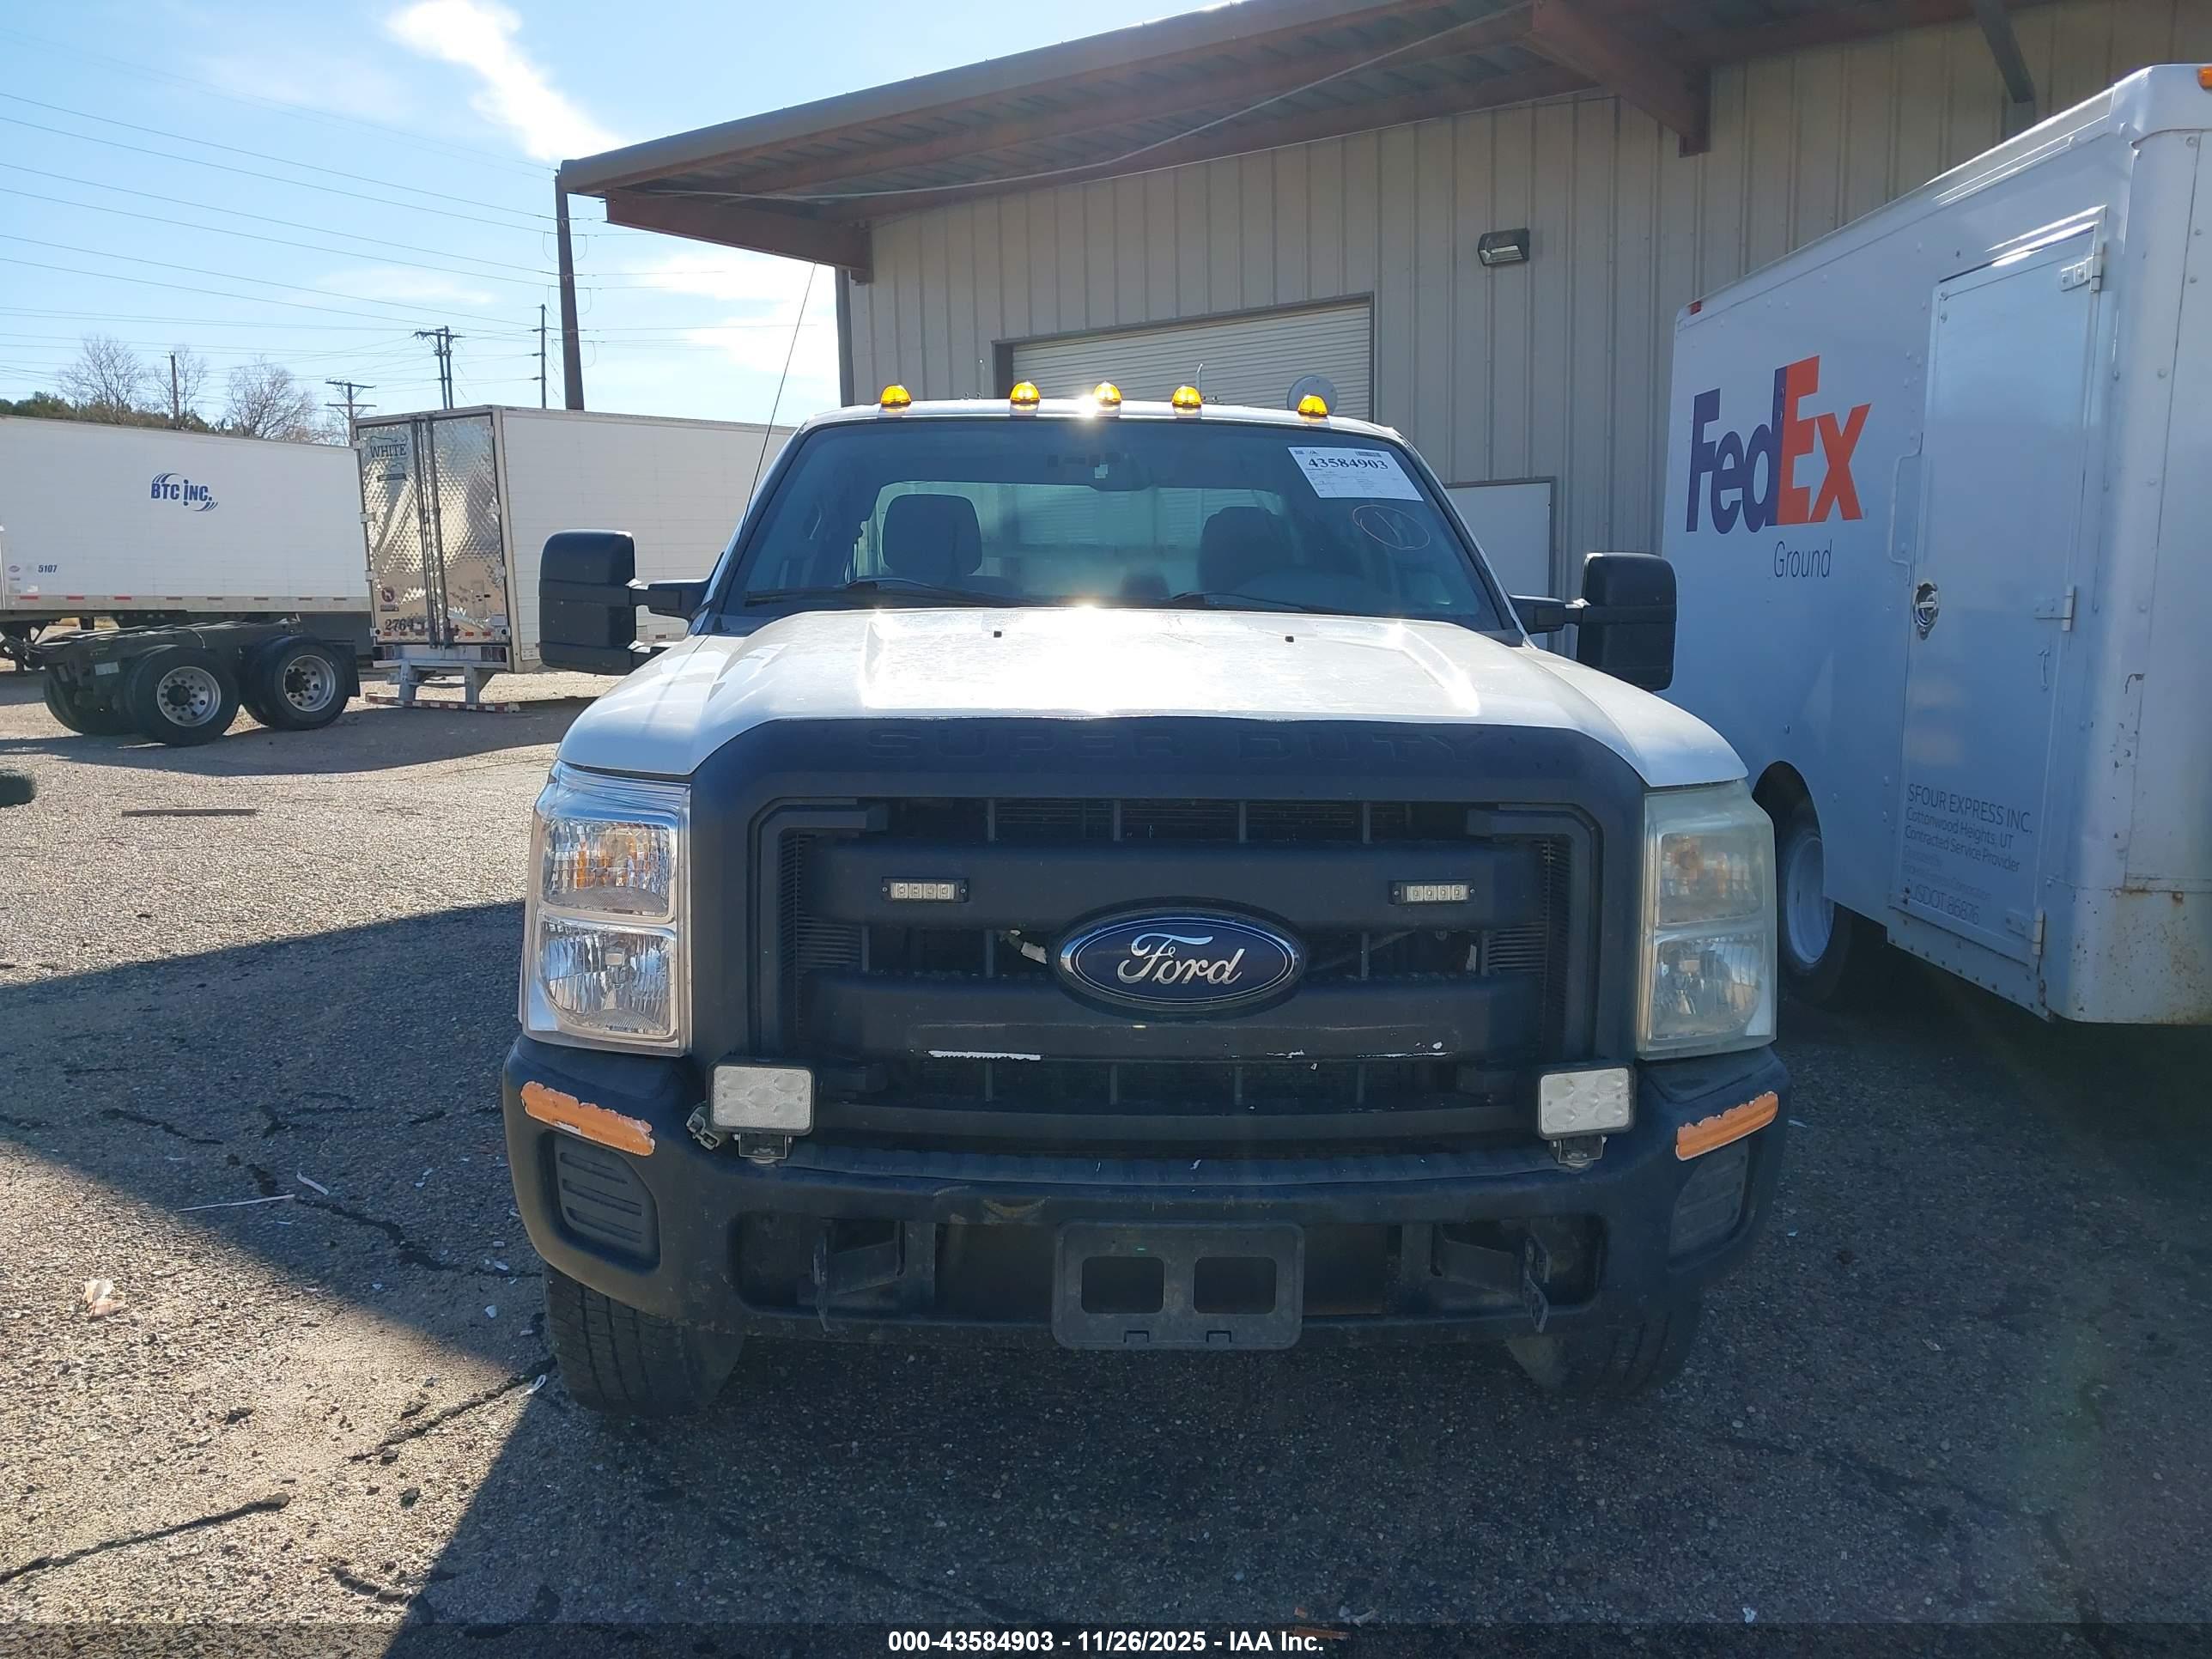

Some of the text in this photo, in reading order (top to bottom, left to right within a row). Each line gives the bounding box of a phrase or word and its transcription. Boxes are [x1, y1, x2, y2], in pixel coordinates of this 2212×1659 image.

[370, 443, 407, 459] WHITE
[1308, 457, 1389, 471] 43584903
[1686, 355, 1872, 535] FedEx
[150, 483, 180, 501] BTC
[38, 564, 58, 574] 5107
[1773, 538, 1833, 578] Ground
[866, 727, 1483, 763] SUPER DUTY
[1905, 806, 1960, 835] Cottonwood
[2000, 833, 2014, 850] UT
[1907, 782, 2033, 835] SFOUR EXPRESS INC.
[1904, 824, 1949, 851] Contracted
[1950, 837, 1982, 861] Service
[1982, 848, 2021, 873] Provider
[1116, 932, 1246, 985] Ford
